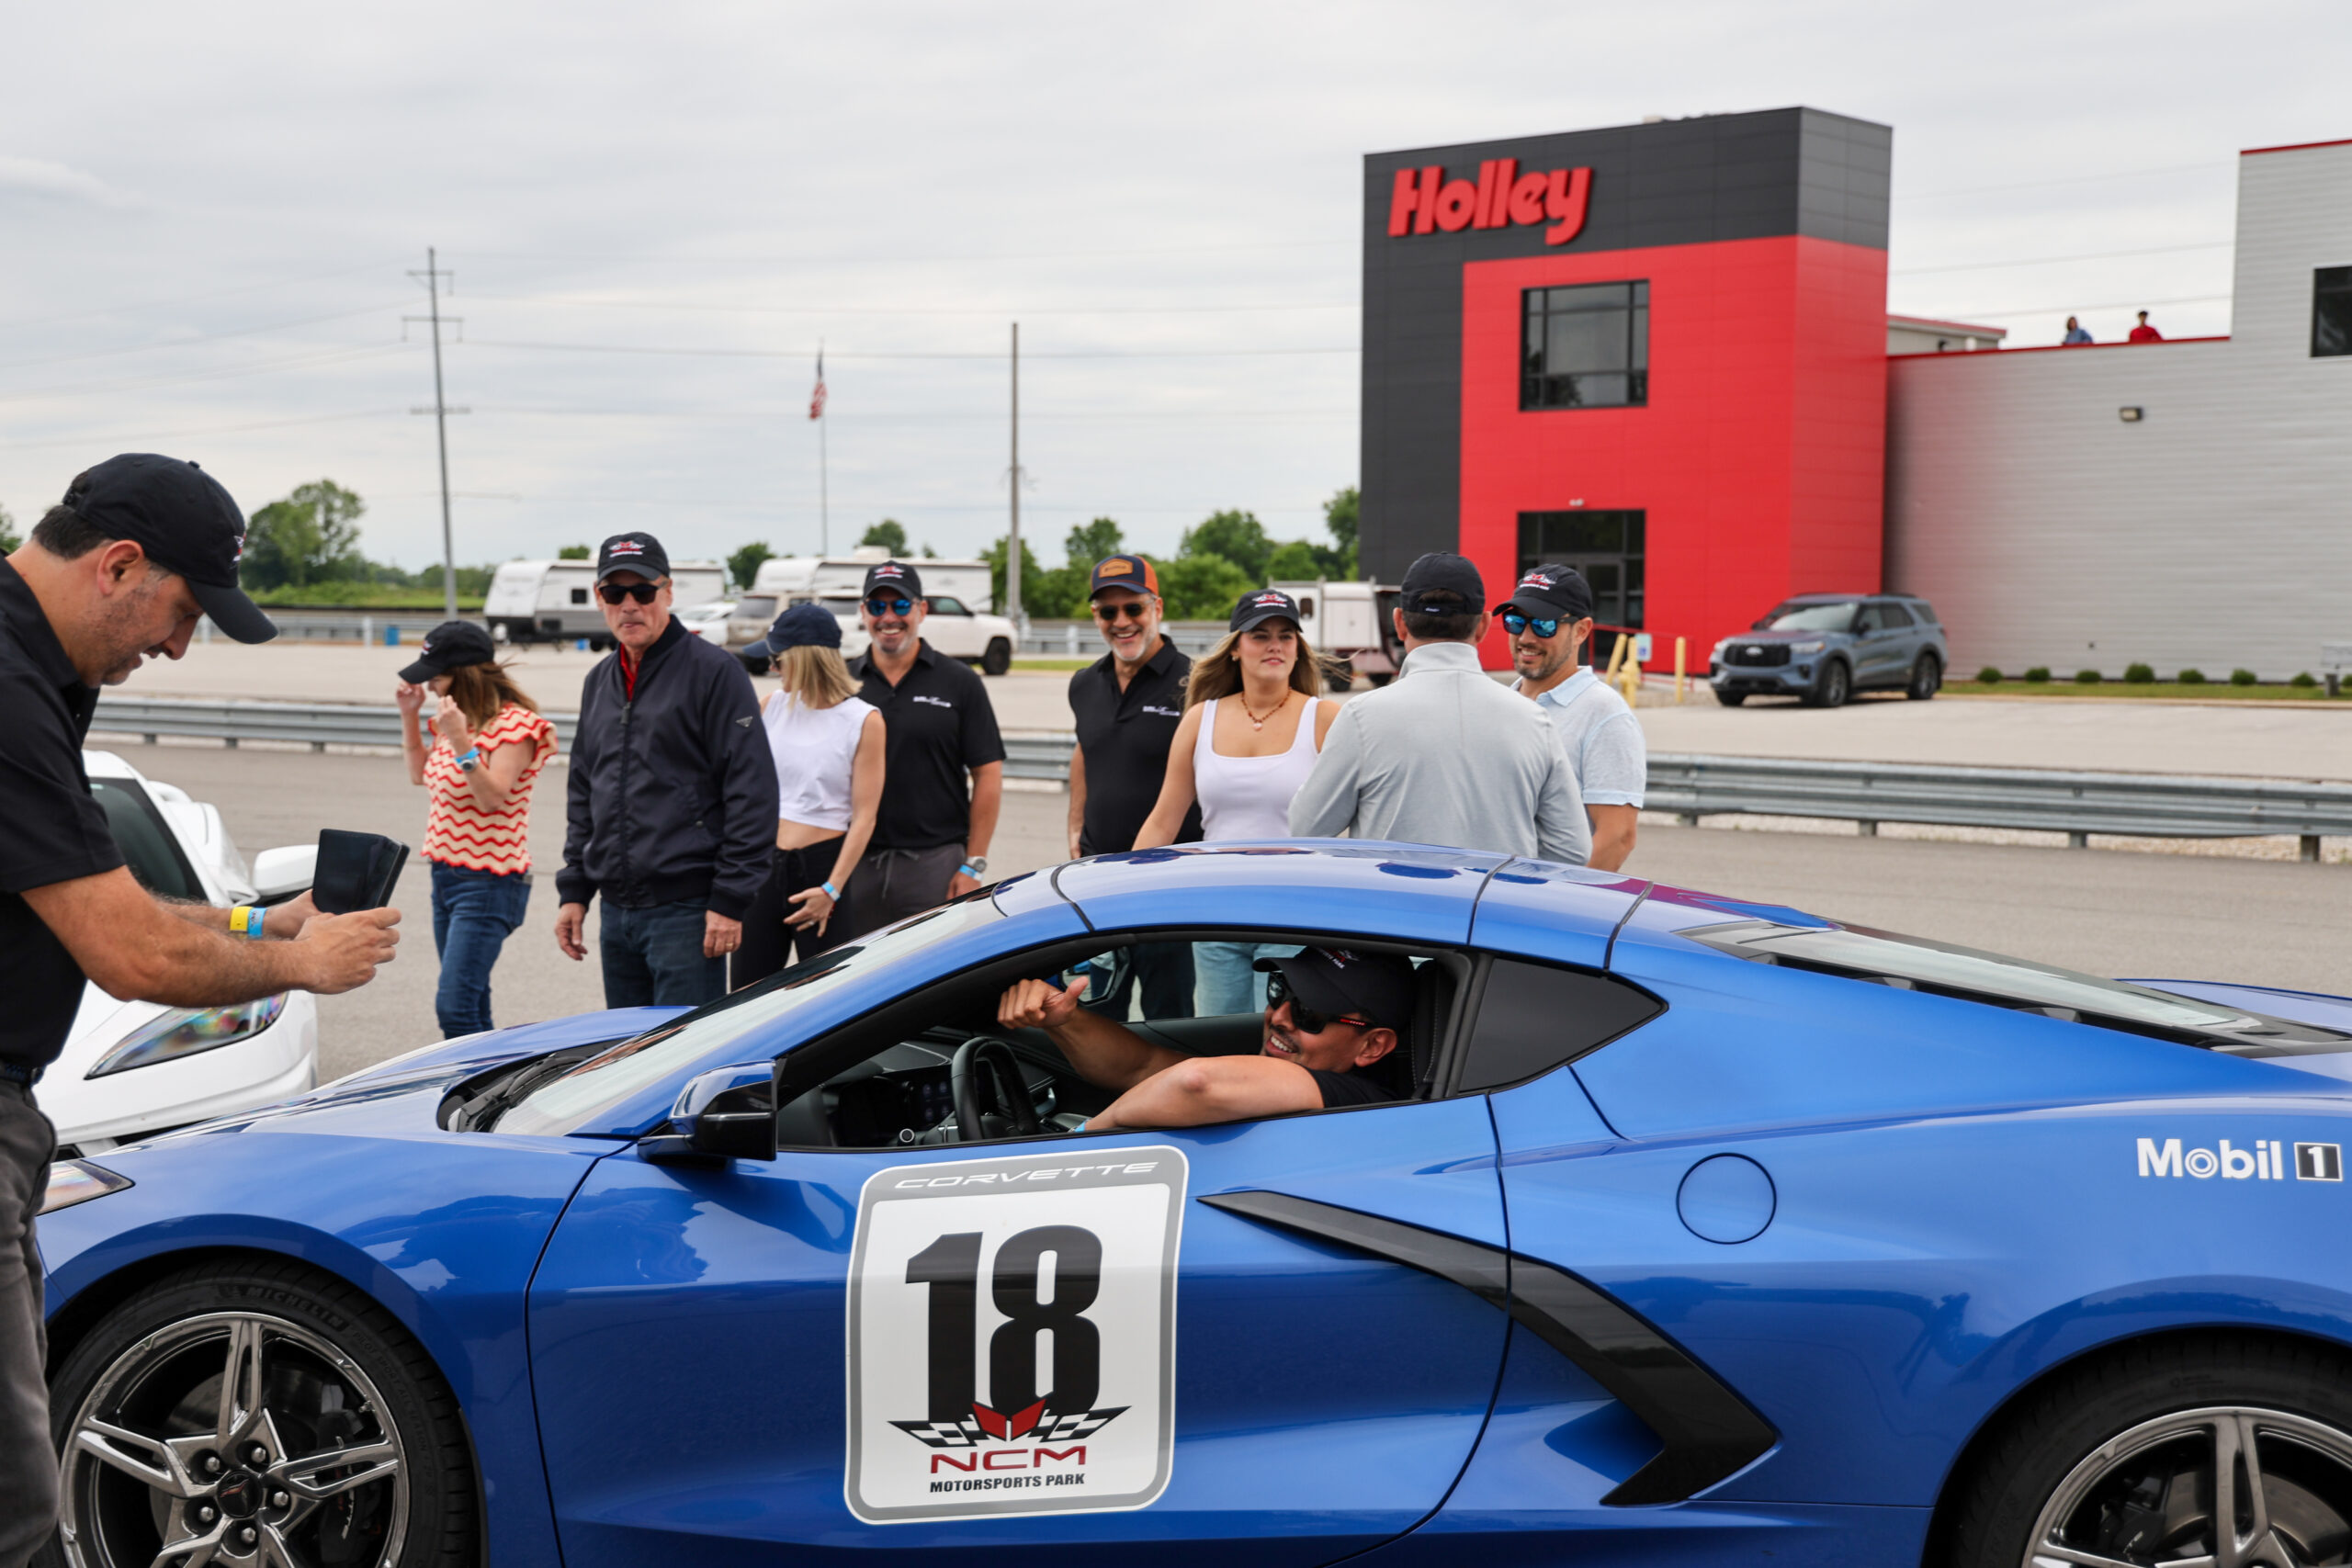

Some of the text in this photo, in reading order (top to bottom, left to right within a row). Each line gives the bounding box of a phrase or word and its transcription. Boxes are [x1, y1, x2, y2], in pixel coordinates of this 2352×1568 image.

[1387, 158, 1592, 245] Holley
[894, 1161, 1159, 1189] CORVETTE
[2136, 1137, 2283, 1179] Mobil
[246, 1286, 344, 1330] MICHELIN
[905, 1224, 1102, 1423] 18
[931, 1445, 1087, 1473] NCM
[930, 1472, 1085, 1494] MOTORSPORTS PARK
